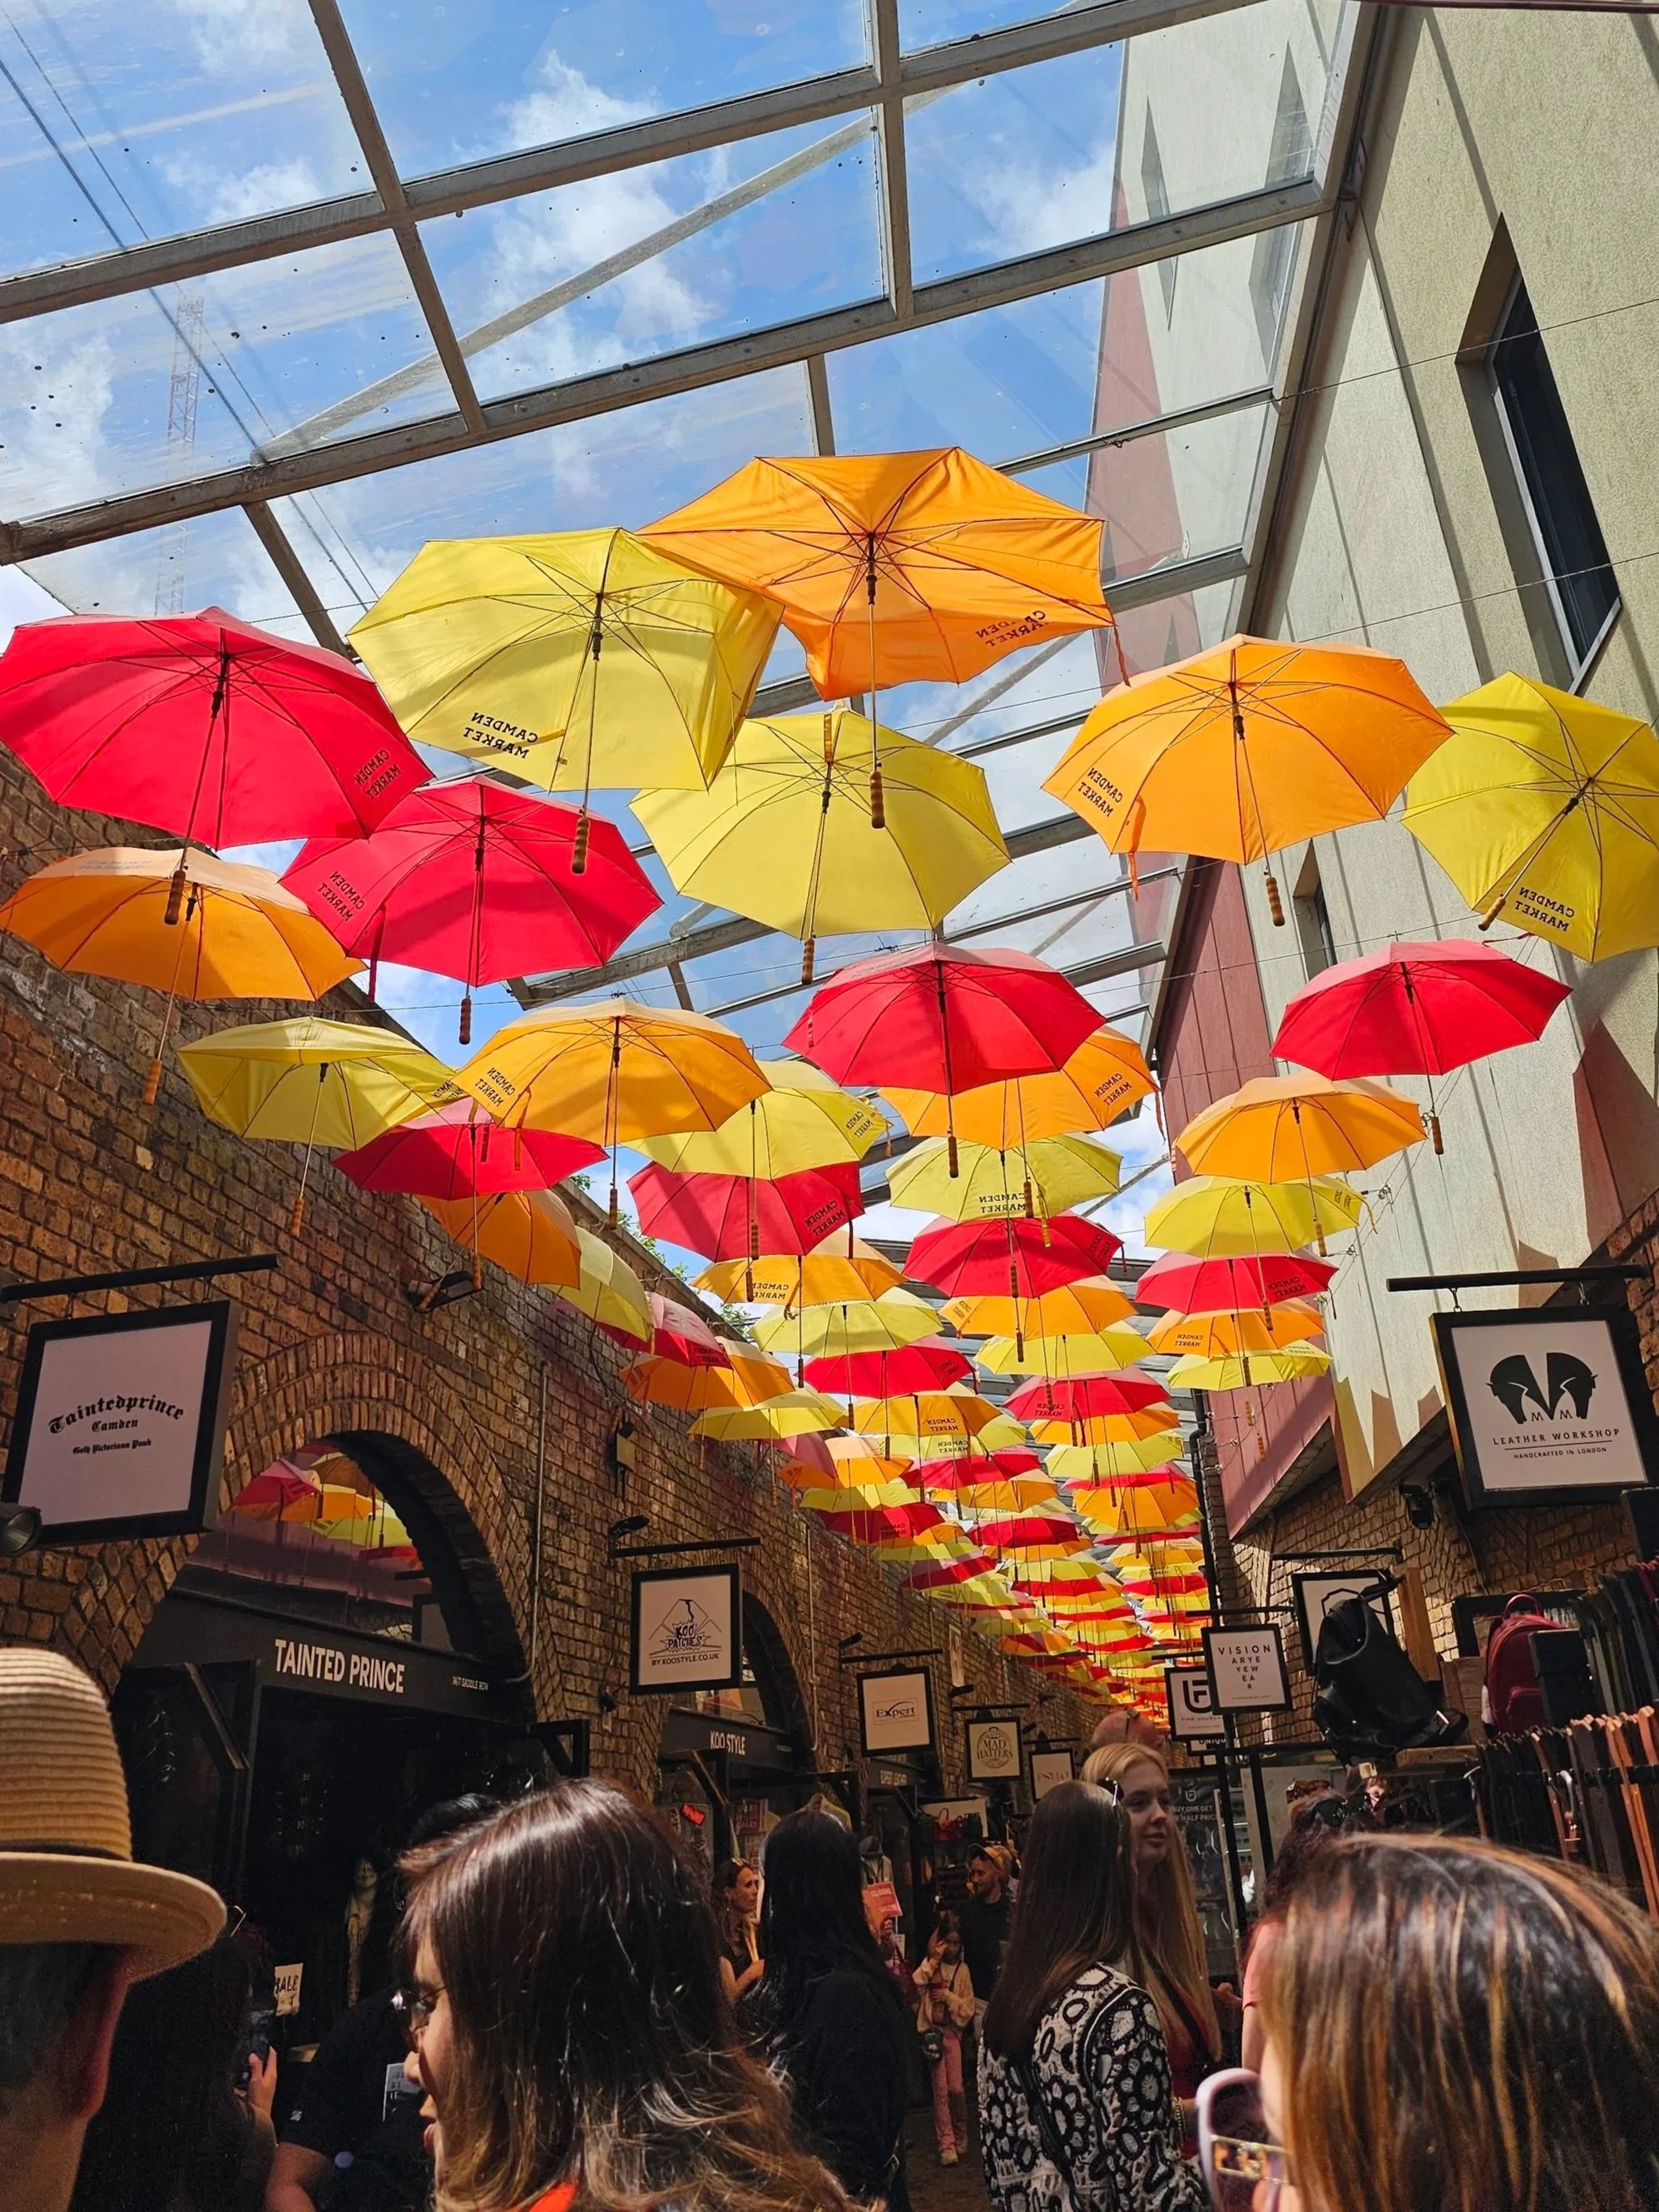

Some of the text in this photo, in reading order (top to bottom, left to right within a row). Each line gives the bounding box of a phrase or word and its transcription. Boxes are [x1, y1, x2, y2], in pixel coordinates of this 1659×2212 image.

[48, 1394, 184, 1433] Taintedprince
[92, 1419, 138, 1432] Camden
[1493, 1428, 1620, 1446] LEATHER WORKSHOP
[1513, 1450, 1563, 1459] HANDCRAFTED
[1577, 1446, 1607, 1455] LONDON
[675, 1625, 695, 1639] KOO
[668, 1635, 702, 1649] PATCHES
[1218, 1644, 1271, 1655] VISION
[662, 1653, 720, 1664] KOOSTYLE.CO.UK
[1231, 1656, 1260, 1664] ARYE
[275, 1639, 405, 1693] TAINTED PRINCE
[876, 1707, 915, 1719] Expert
[710, 1731, 745, 1755] KOO STYLE
[983, 1739, 1007, 1748] MAD
[977, 1748, 1013, 1759] HATTERS
